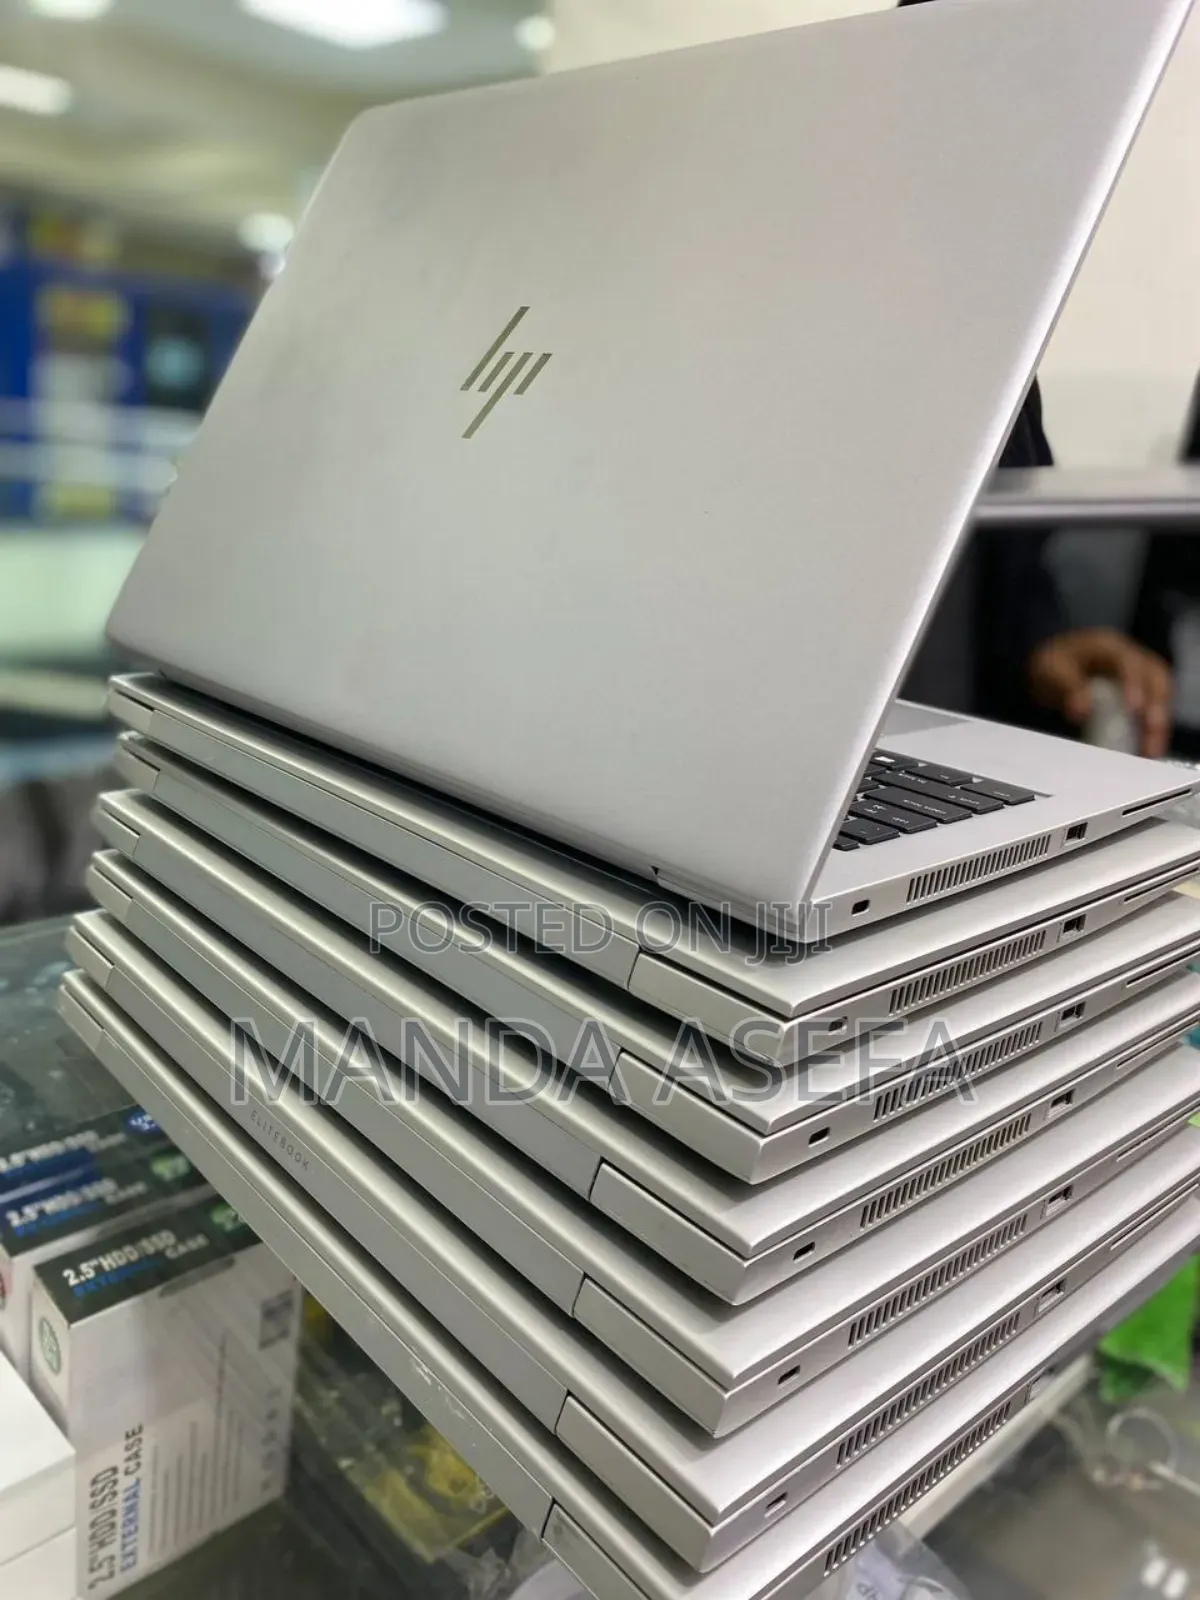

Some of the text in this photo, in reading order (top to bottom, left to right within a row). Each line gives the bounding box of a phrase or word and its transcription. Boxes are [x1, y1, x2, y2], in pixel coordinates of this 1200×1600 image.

[251, 1110, 309, 1170] ELITEBOOK
[120, 1423, 143, 1573] EXTERNAL CASE
